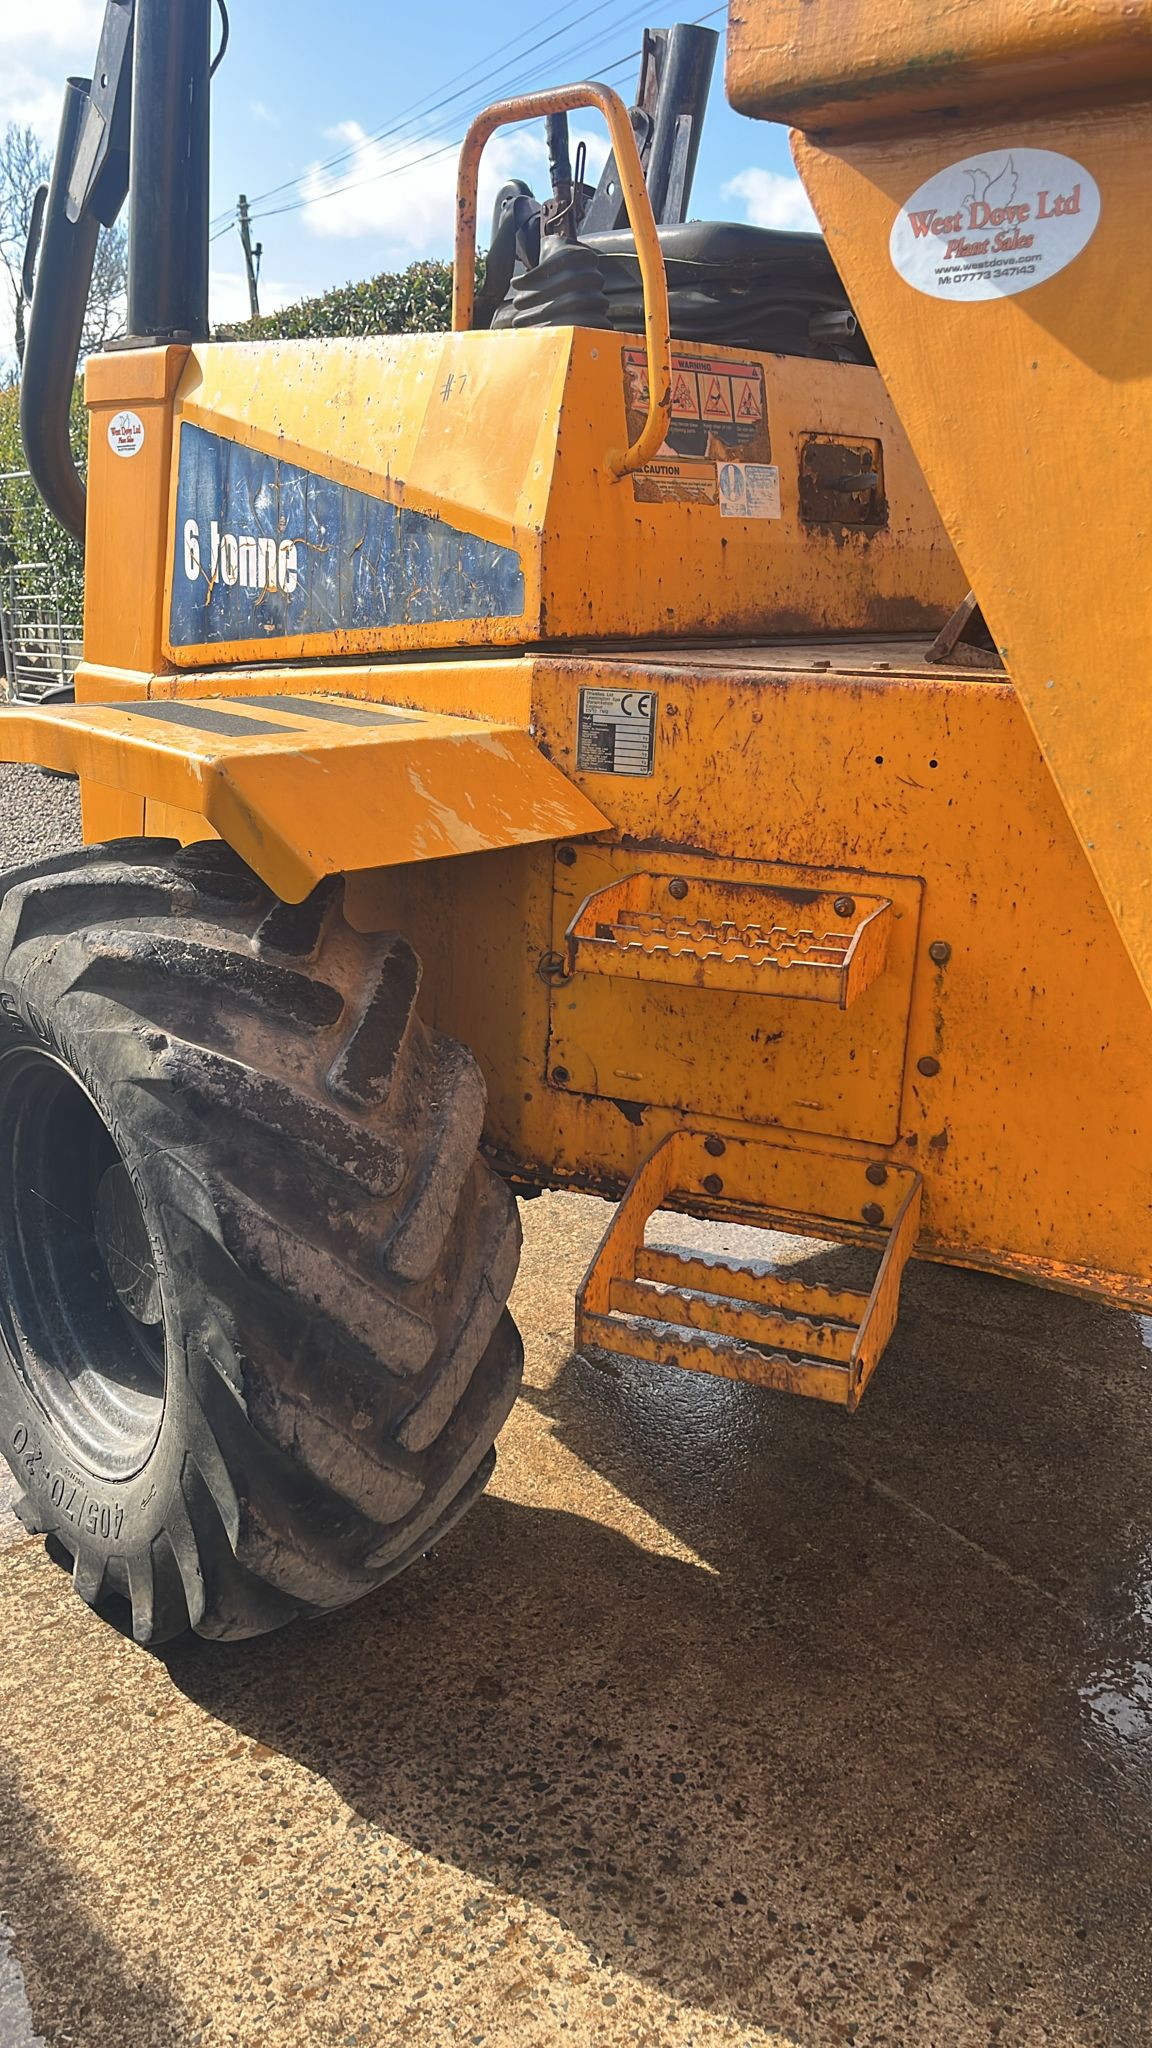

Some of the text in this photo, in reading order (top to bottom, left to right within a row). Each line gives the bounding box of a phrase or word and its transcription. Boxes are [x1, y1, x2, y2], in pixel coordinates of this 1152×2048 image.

[907, 184, 1081, 239] West Dove Ltd
[943, 230, 1035, 260] Plant Sales
[934, 254, 1042, 274] www.westdove.com
[953, 271, 992, 284] 07773
[678, 360, 712, 371] WARNING
[644, 465, 680, 475] CAUTION
[183, 519, 298, 593] 6 tonne
